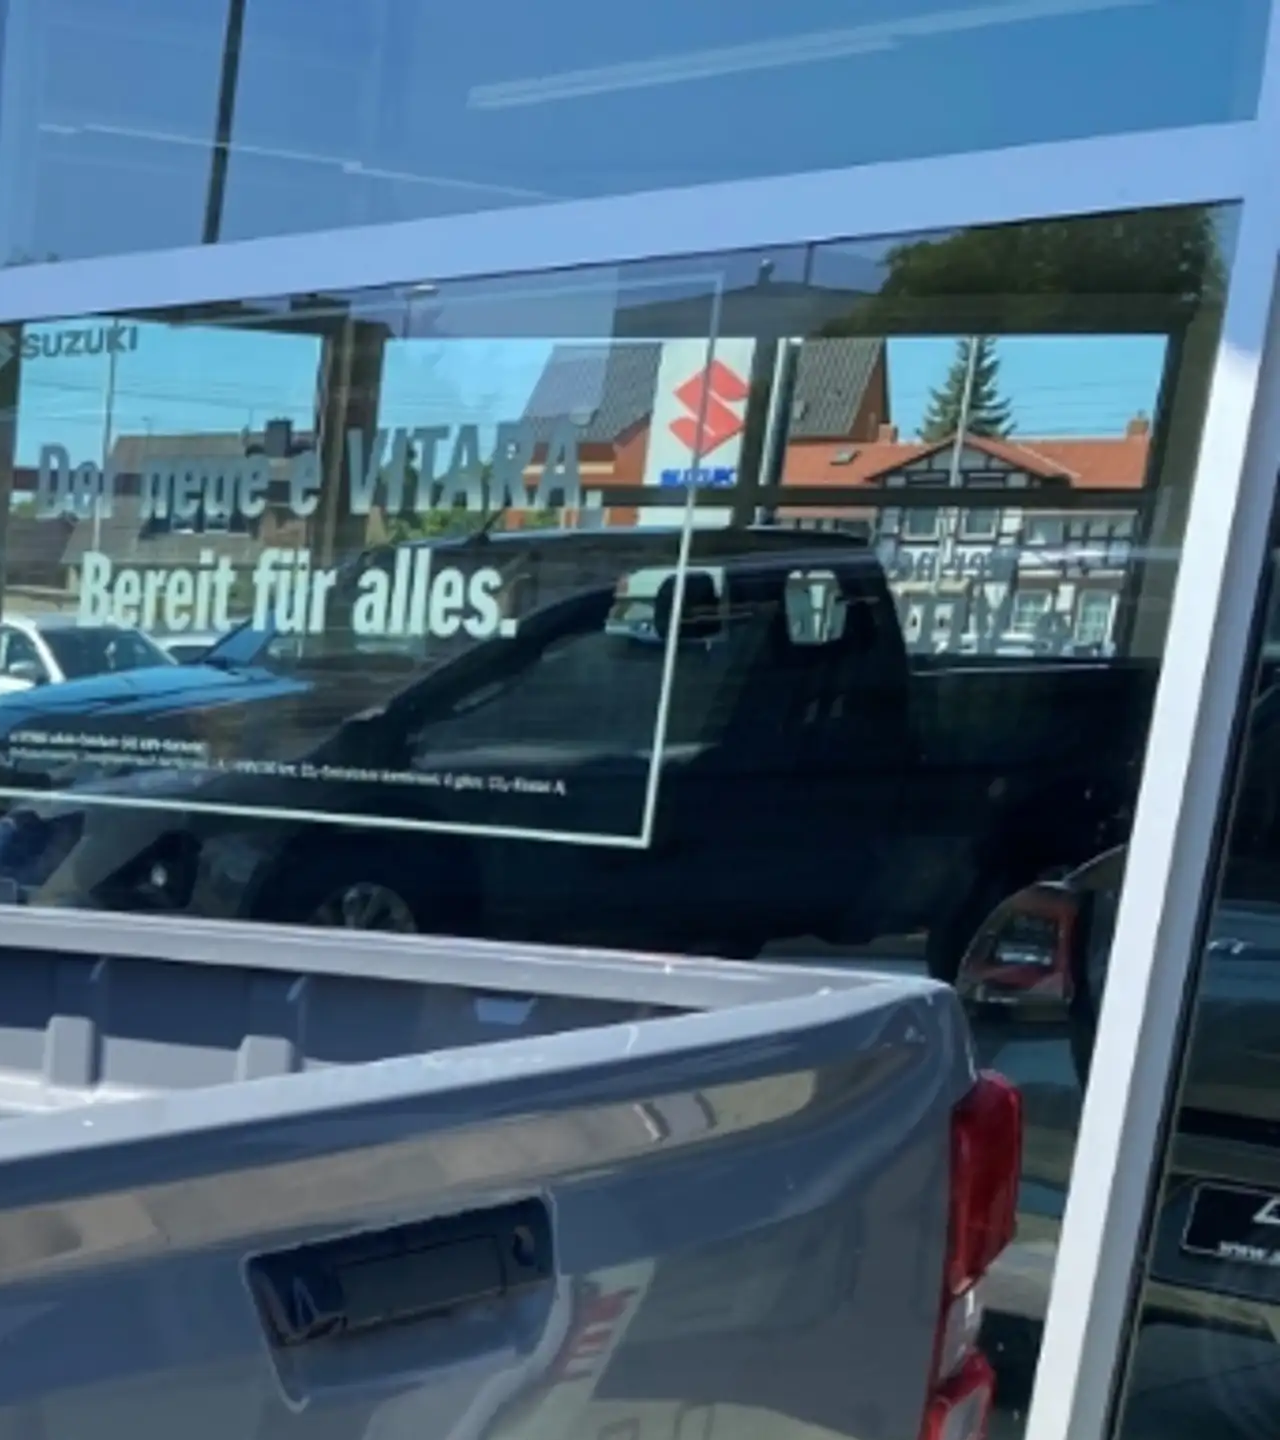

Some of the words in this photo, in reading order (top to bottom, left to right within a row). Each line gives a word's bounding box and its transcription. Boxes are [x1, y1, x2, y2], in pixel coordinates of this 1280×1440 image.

[20, 325, 138, 360] SUZUKI
[36, 444, 116, 520] Der
[142, 453, 269, 519] neue
[290, 450, 320, 517] e
[77, 548, 237, 632] Bereit
[252, 547, 339, 634] für
[352, 547, 518, 639] alles.
